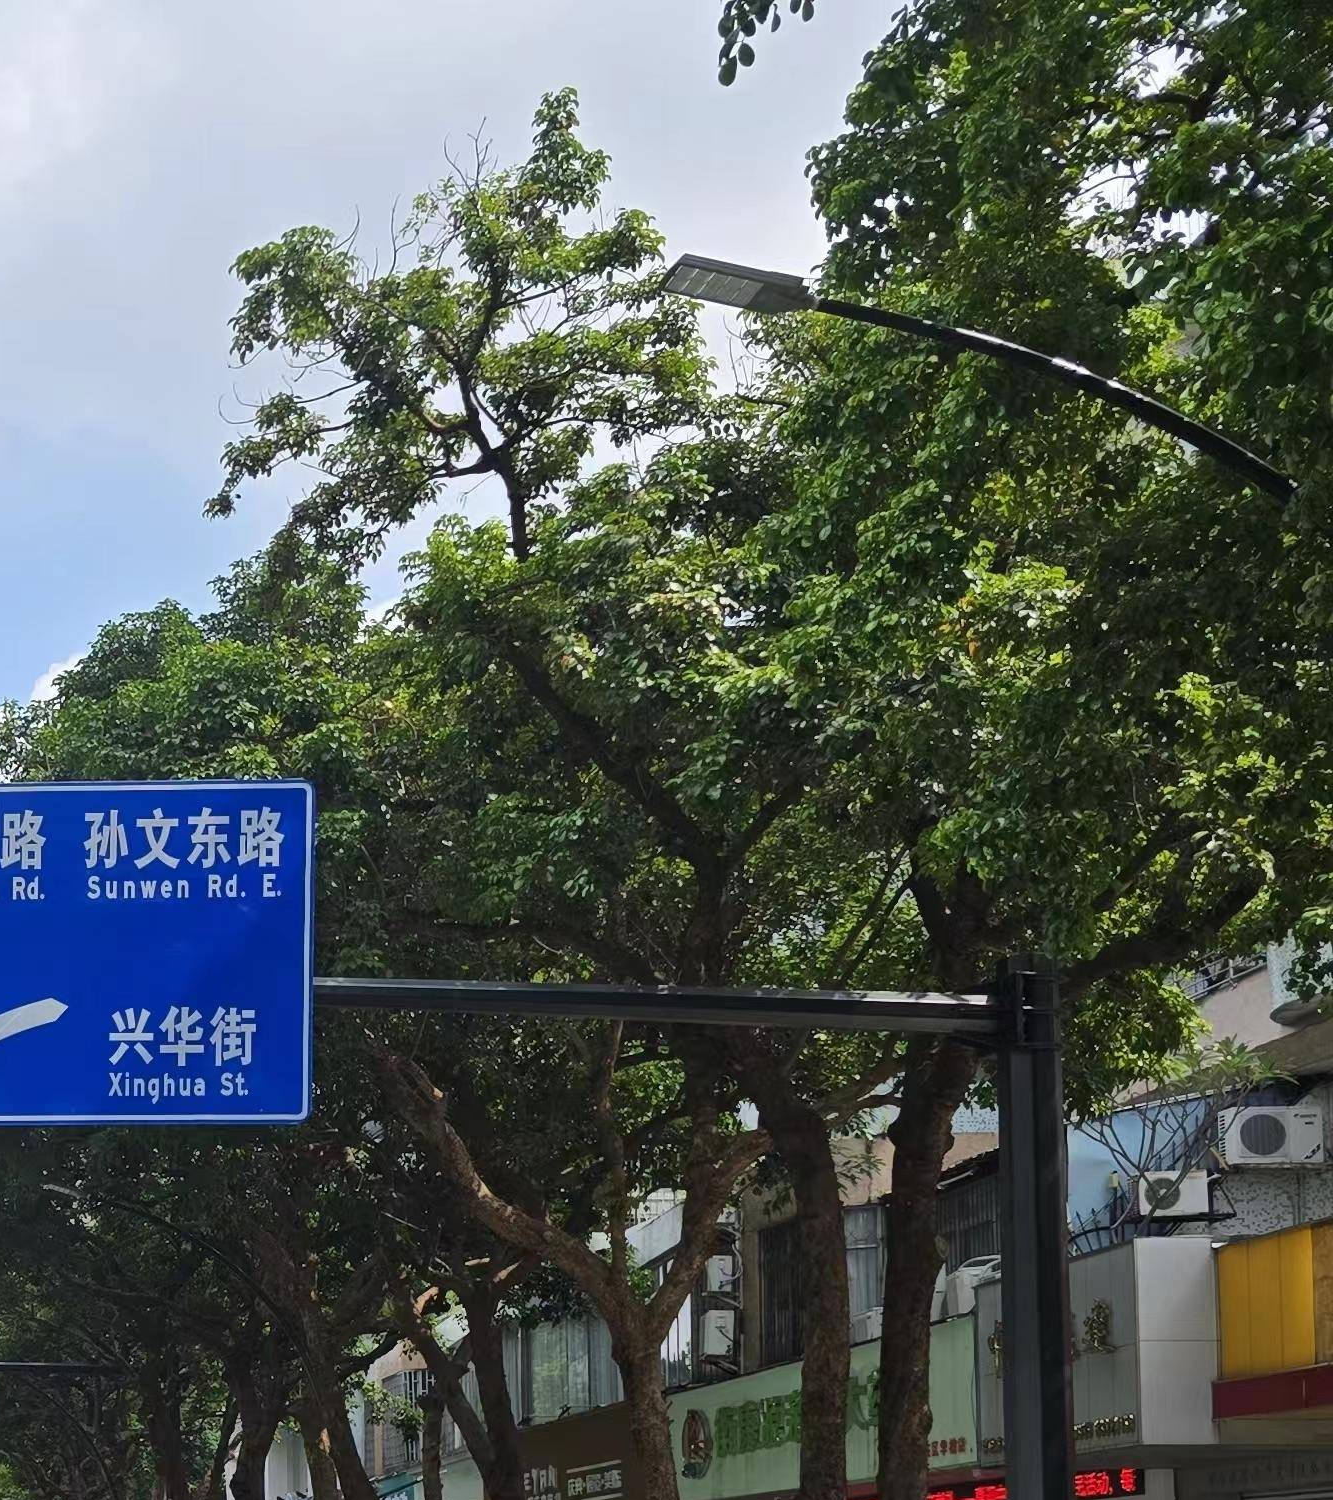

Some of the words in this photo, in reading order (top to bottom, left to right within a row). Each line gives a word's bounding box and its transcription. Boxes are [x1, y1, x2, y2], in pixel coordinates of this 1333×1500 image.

[83, 806, 285, 870] 孙文东路
[12, 878, 45, 900] Rd.
[86, 875, 190, 900] Sunwen
[207, 874, 246, 899] Rd.
[263, 873, 282, 898] E.
[108, 1005, 256, 1067] 兴华街
[108, 1072, 206, 1103] Xinghua
[220, 1073, 249, 1097] St.
